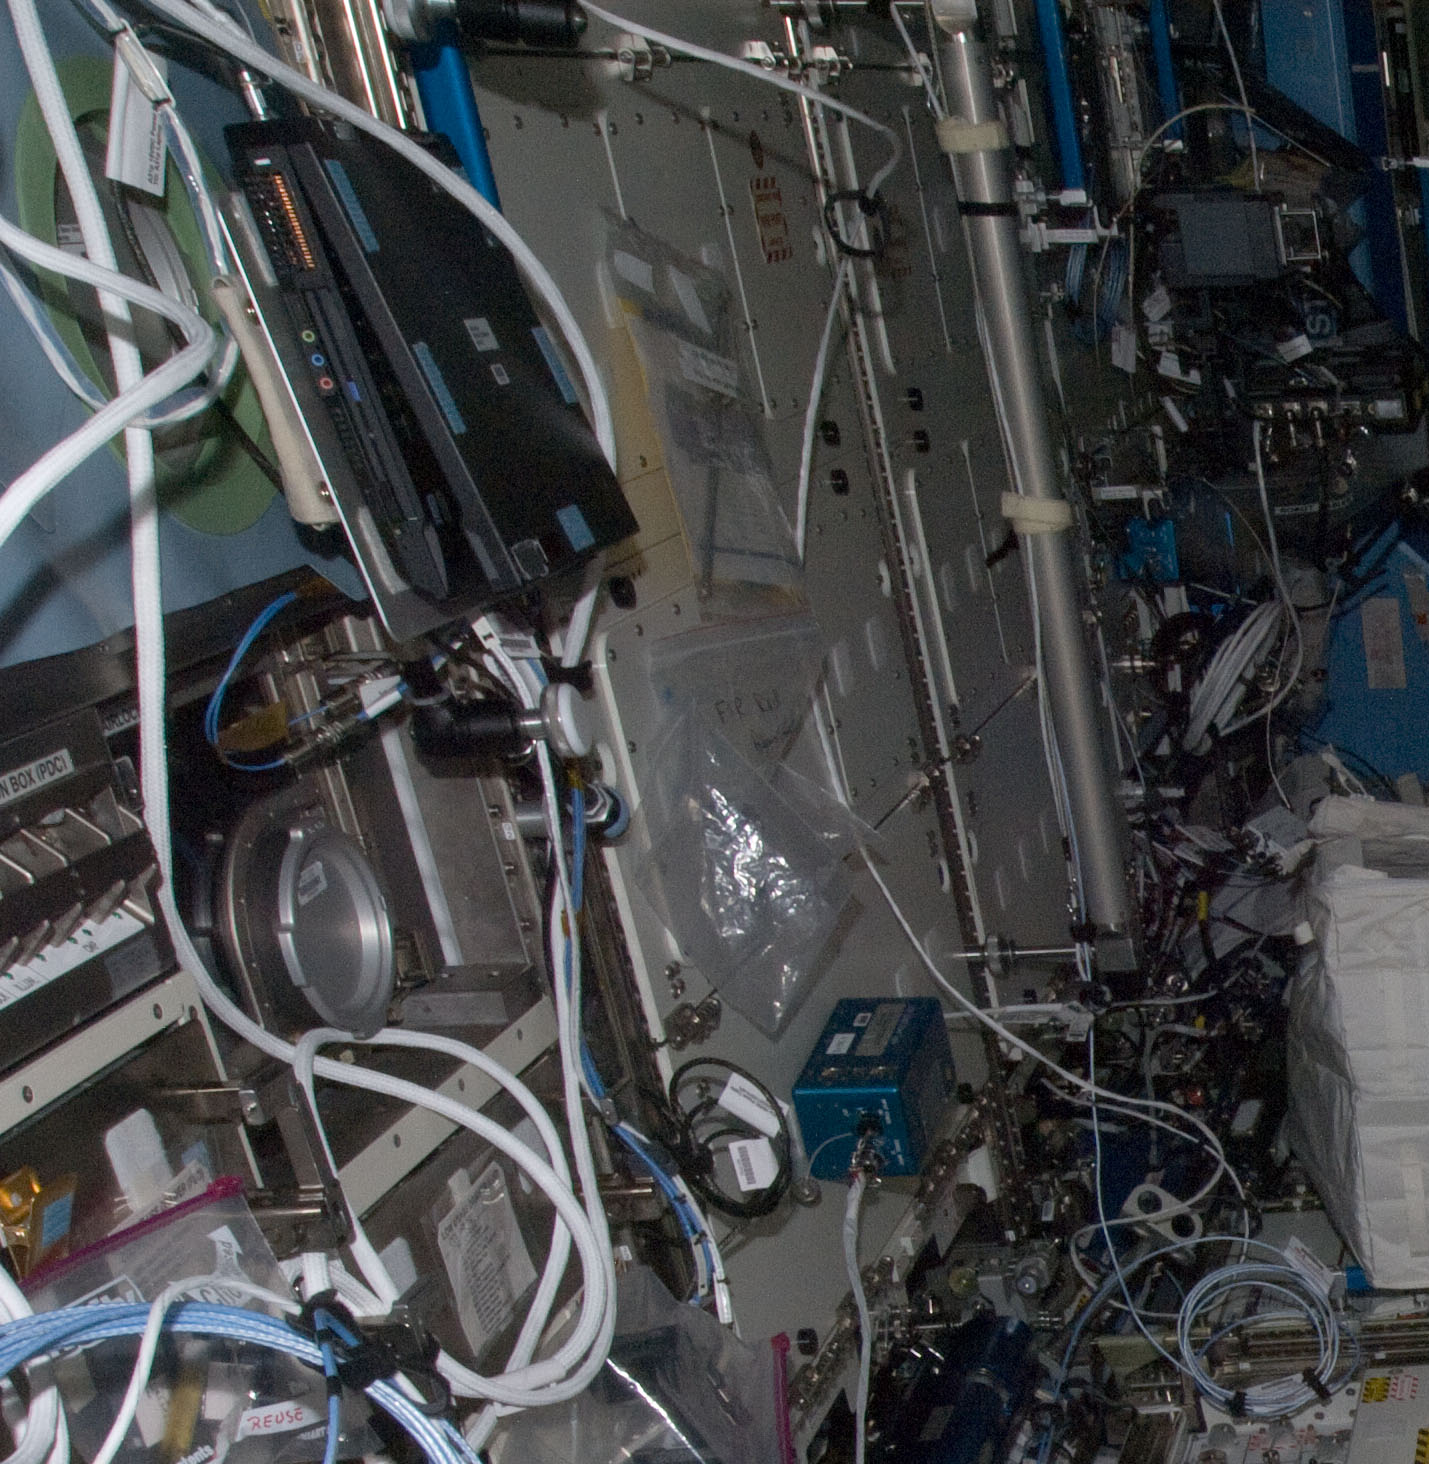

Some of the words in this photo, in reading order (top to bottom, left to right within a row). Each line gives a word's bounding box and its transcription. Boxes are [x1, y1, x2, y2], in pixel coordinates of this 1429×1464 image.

[9, 769, 36, 793] BOX
[35, 753, 69, 780] (PDC)
[247, 1407, 304, 1432] REUSE
